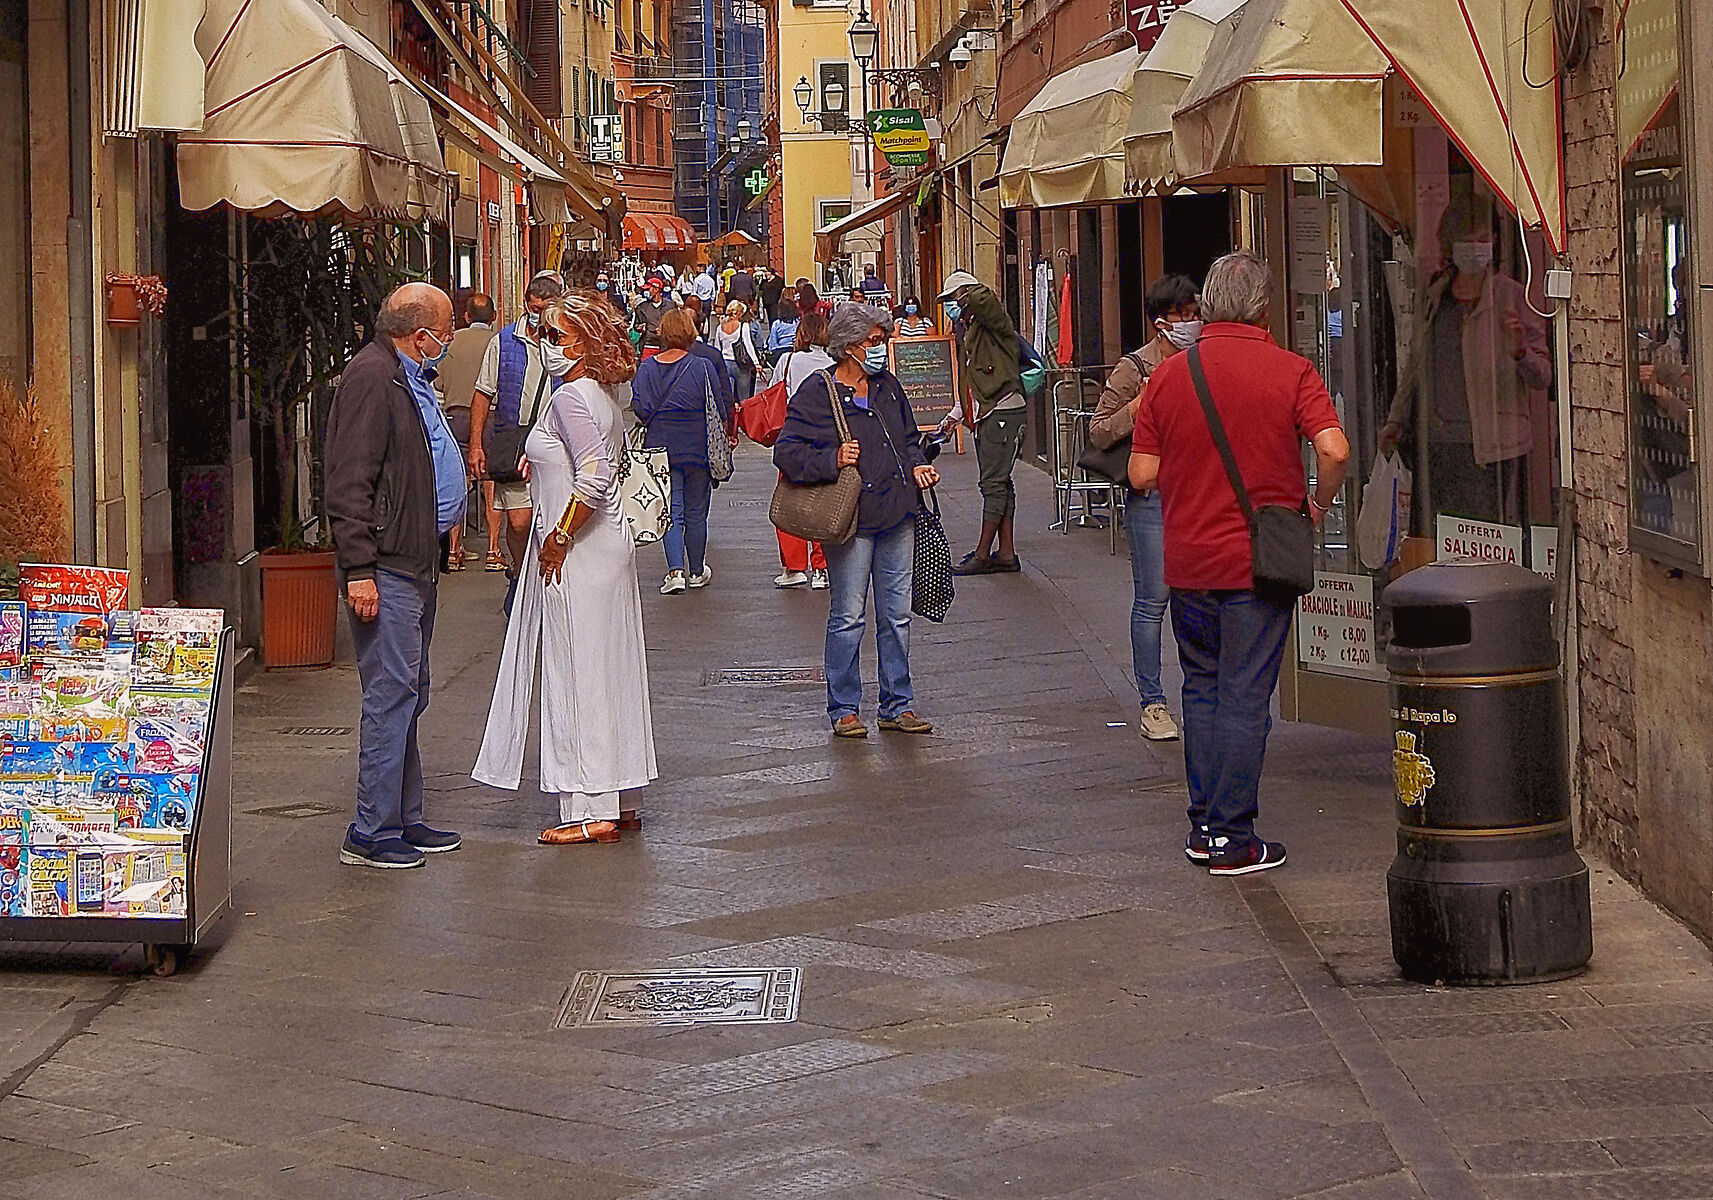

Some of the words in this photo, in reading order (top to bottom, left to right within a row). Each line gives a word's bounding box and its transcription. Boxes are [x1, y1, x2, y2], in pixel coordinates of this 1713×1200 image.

[888, 116, 914, 125] Sisal
[880, 135, 922, 145] Matchpoint
[1457, 523, 1502, 540] OFFERTA
[1444, 537, 1516, 563] SALSICCIA
[1318, 579, 1355, 592] OFFERTA
[47, 593, 100, 609] NINJAGO
[1301, 595, 1339, 617] BRACIOLE
[1346, 599, 1373, 621] MAIALE
[15, 746, 30, 754] CITY
